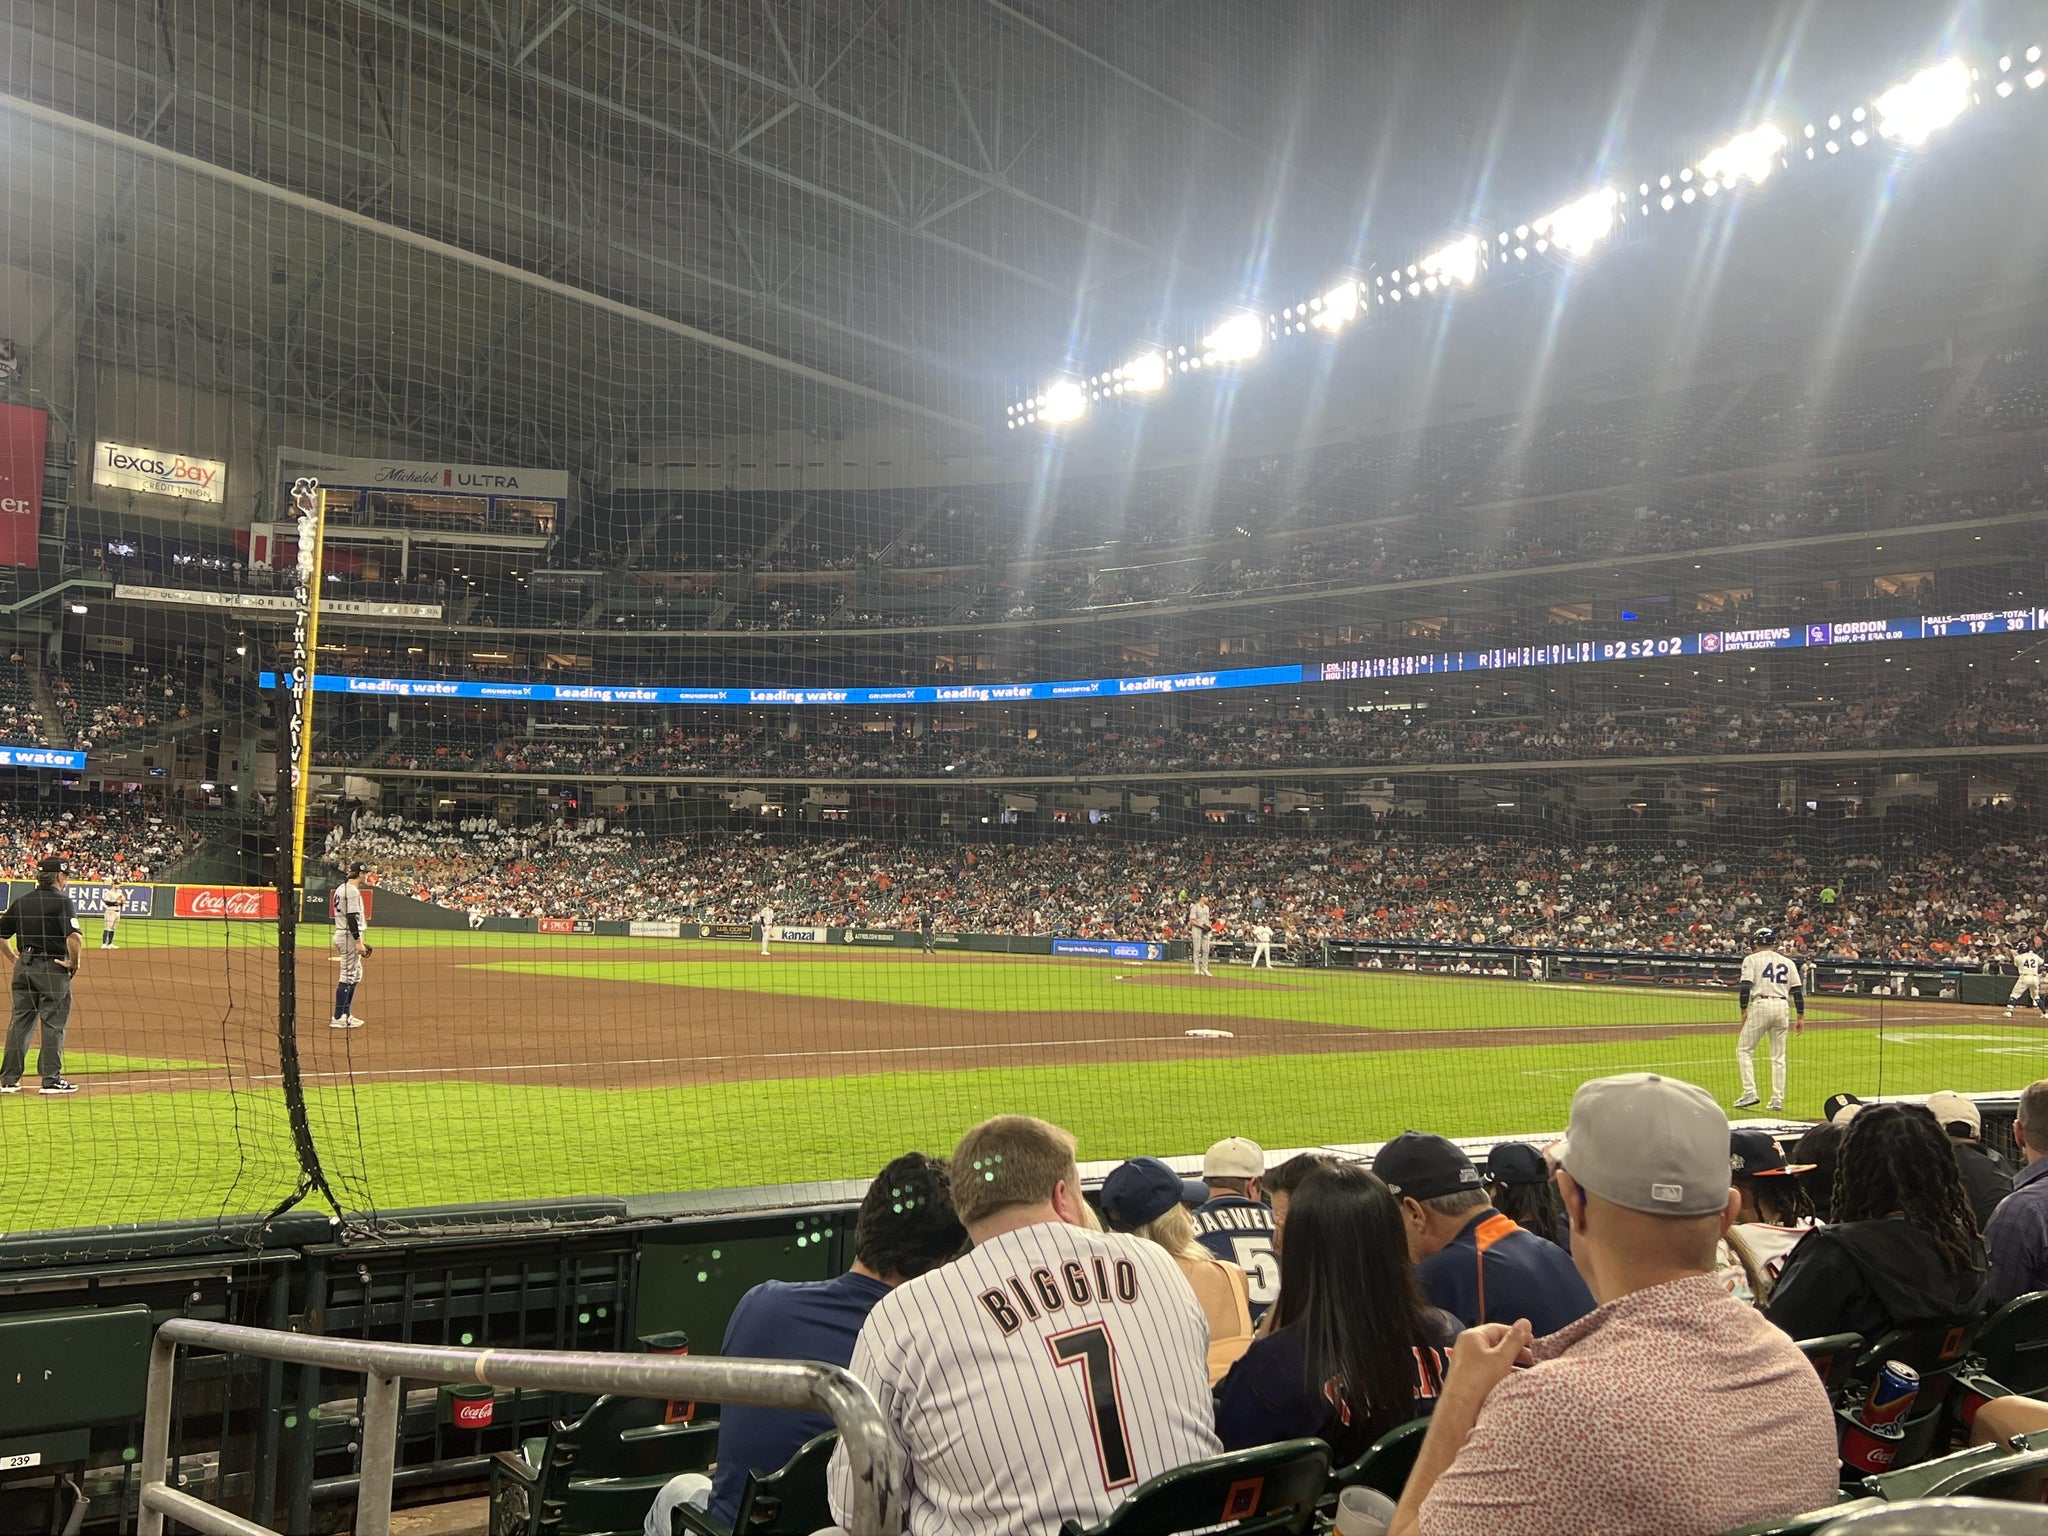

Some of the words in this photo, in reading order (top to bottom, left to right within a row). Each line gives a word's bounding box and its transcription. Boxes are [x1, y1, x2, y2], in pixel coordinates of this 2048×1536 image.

[104, 447, 165, 475] Texas
[174, 458, 216, 488] Bay
[375, 467, 438, 484] Michelob
[458, 474, 519, 489] ULTRA
[142, 480, 176, 493] CREDIT
[177, 486, 211, 498] UNION
[329, 603, 360, 611] BEER
[1927, 615, 1952, 624] BALLS
[1960, 612, 1994, 622] STRIKES
[2002, 610, 2029, 618] TOTAL
[1834, 620, 1887, 635] GORDON
[1932, 624, 1947, 636] 11
[1969, 621, 1986, 633] 19
[2007, 619, 2024, 630] 30
[1725, 628, 1790, 643] MATTHEWS
[1834, 634, 1852, 643] RHP,
[1852, 633, 1866, 641] 0-0
[1886, 631, 1903, 639] 0.00
[1725, 641, 1740, 650] EXIT
[1741, 640, 1776, 649] VELOCITY:
[1479, 654, 1488, 666] R
[1507, 652, 1517, 664] H
[1537, 650, 1545, 662] E
[1567, 648, 1575, 660] L
[1326, 663, 1340, 671] COL
[1325, 672, 1341, 680] HOU
[349, 679, 409, 695] Leading
[412, 683, 458, 694] water
[1119, 679, 1172, 692] Leading
[1175, 675, 1216, 687] water
[480, 687, 523, 695] GRUNDFOS
[555, 687, 612, 702] Leading
[615, 689, 658, 699] water
[750, 690, 804, 703] Leading
[806, 692, 847, 701] water
[936, 688, 989, 700] Leading
[992, 686, 1032, 697] water
[15, 752, 75, 764] water
[68, 887, 135, 900] ENEY
[306, 895, 324, 903] 326
[72, 900, 148, 912] RANFER
[2023, 959, 2036, 968] 42
[1762, 962, 1789, 984] 42
[1192, 1207, 1276, 1238] BAGWEL
[1230, 1235, 1282, 1304] 5
[978, 1256, 1138, 1337] BIGGIO
[1045, 1320, 1138, 1491] 7
[10, 1456, 30, 1467] 239
